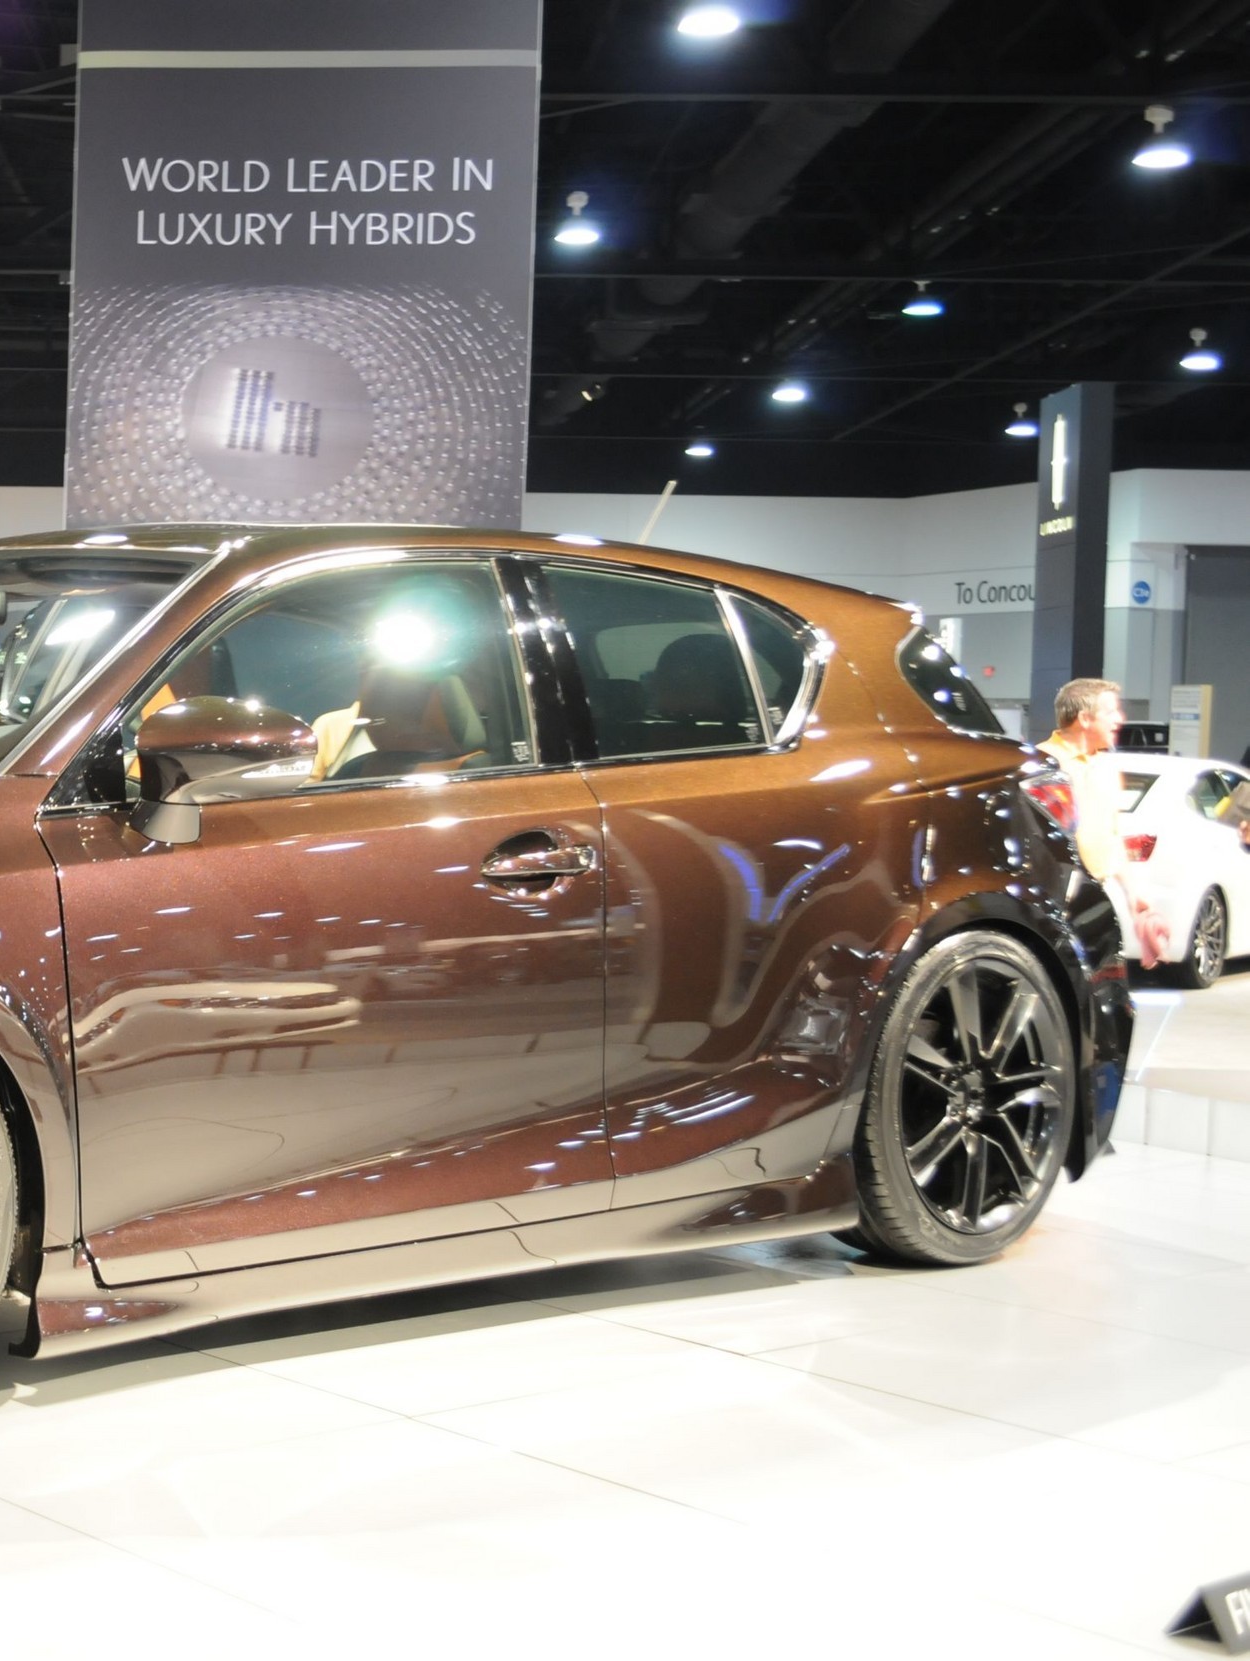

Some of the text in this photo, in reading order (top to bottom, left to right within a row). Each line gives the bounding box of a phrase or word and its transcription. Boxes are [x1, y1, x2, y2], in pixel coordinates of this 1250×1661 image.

[122, 157, 493, 193] WORLD LEADER IN
[137, 210, 477, 246] LUXURY HYBRIDS
[955, 582, 973, 605] To
